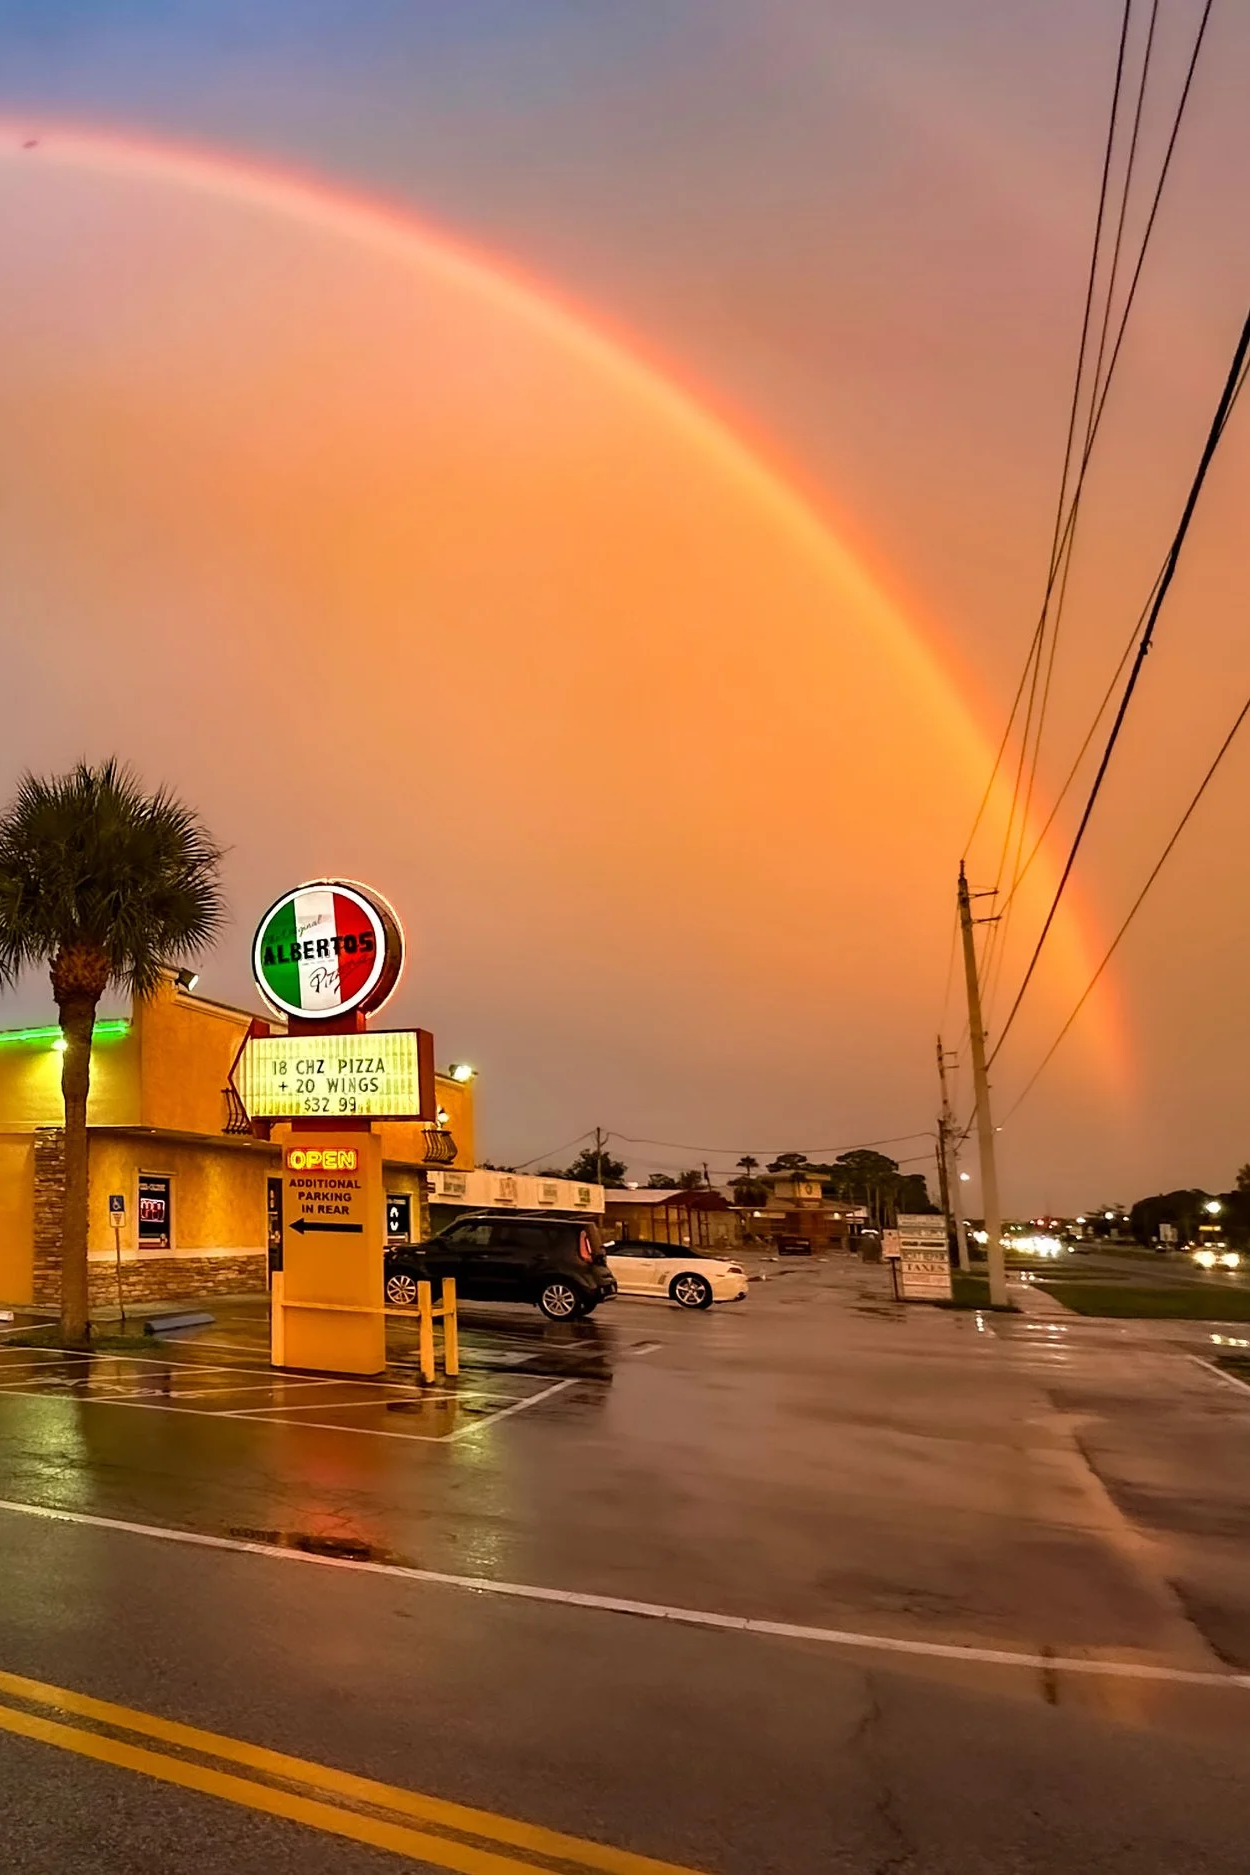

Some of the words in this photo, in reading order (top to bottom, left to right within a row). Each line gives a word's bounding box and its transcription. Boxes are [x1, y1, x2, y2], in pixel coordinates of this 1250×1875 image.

[264, 931, 374, 966] ALBERTOS
[272, 1060, 287, 1075] 18
[296, 1059, 324, 1075] CHZ
[338, 1057, 386, 1074] PIZZA
[296, 1078, 315, 1093] 20
[326, 1077, 379, 1093] WINGS
[290, 1150, 355, 1170] OPEN
[289, 1179, 361, 1189] ADDITIONAL
[297, 1191, 352, 1202] PARKING
[301, 1204, 314, 1213] IN
[318, 1204, 349, 1215] REAR
